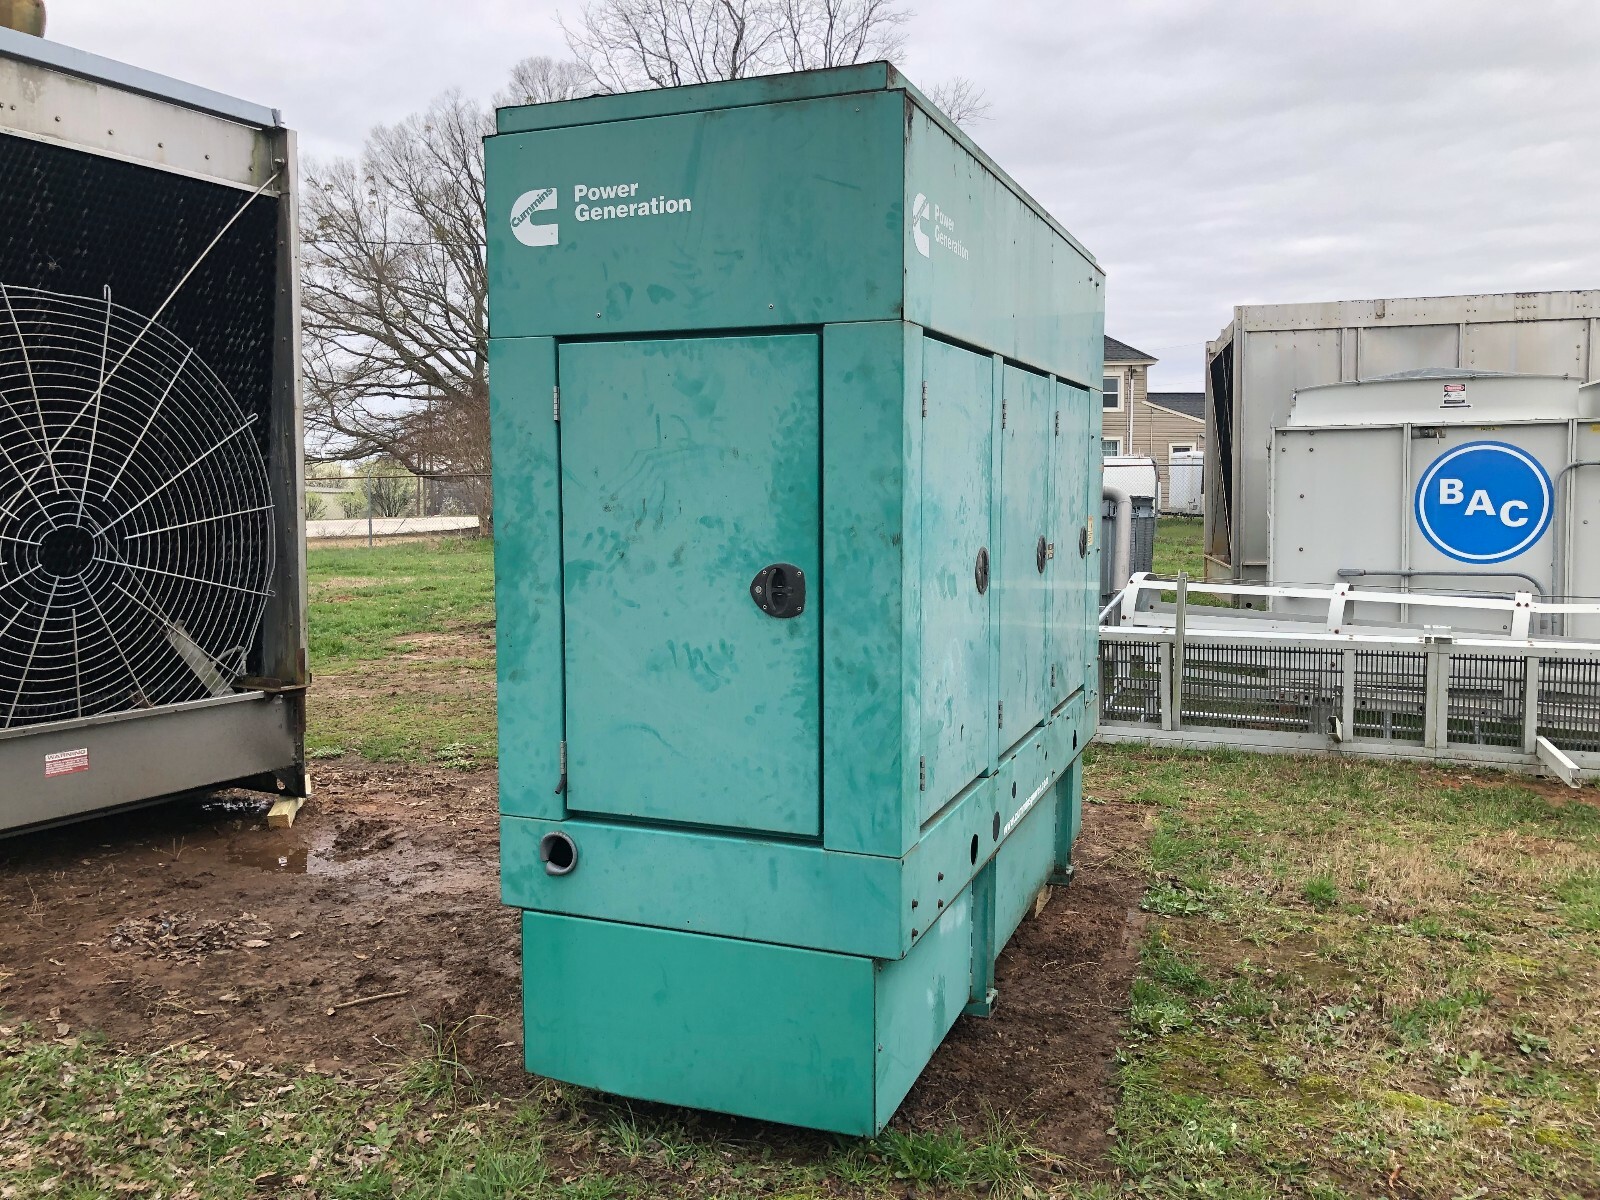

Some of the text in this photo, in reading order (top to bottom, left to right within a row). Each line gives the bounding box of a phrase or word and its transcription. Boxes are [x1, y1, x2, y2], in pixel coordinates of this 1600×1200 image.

[574, 183, 639, 202] Power
[510, 188, 554, 228] Cummins
[574, 195, 692, 222] Generation
[934, 203, 955, 233] Power
[934, 224, 969, 260] Generation
[1439, 478, 1529, 528] BAC
[47, 749, 86, 760] WARNING
